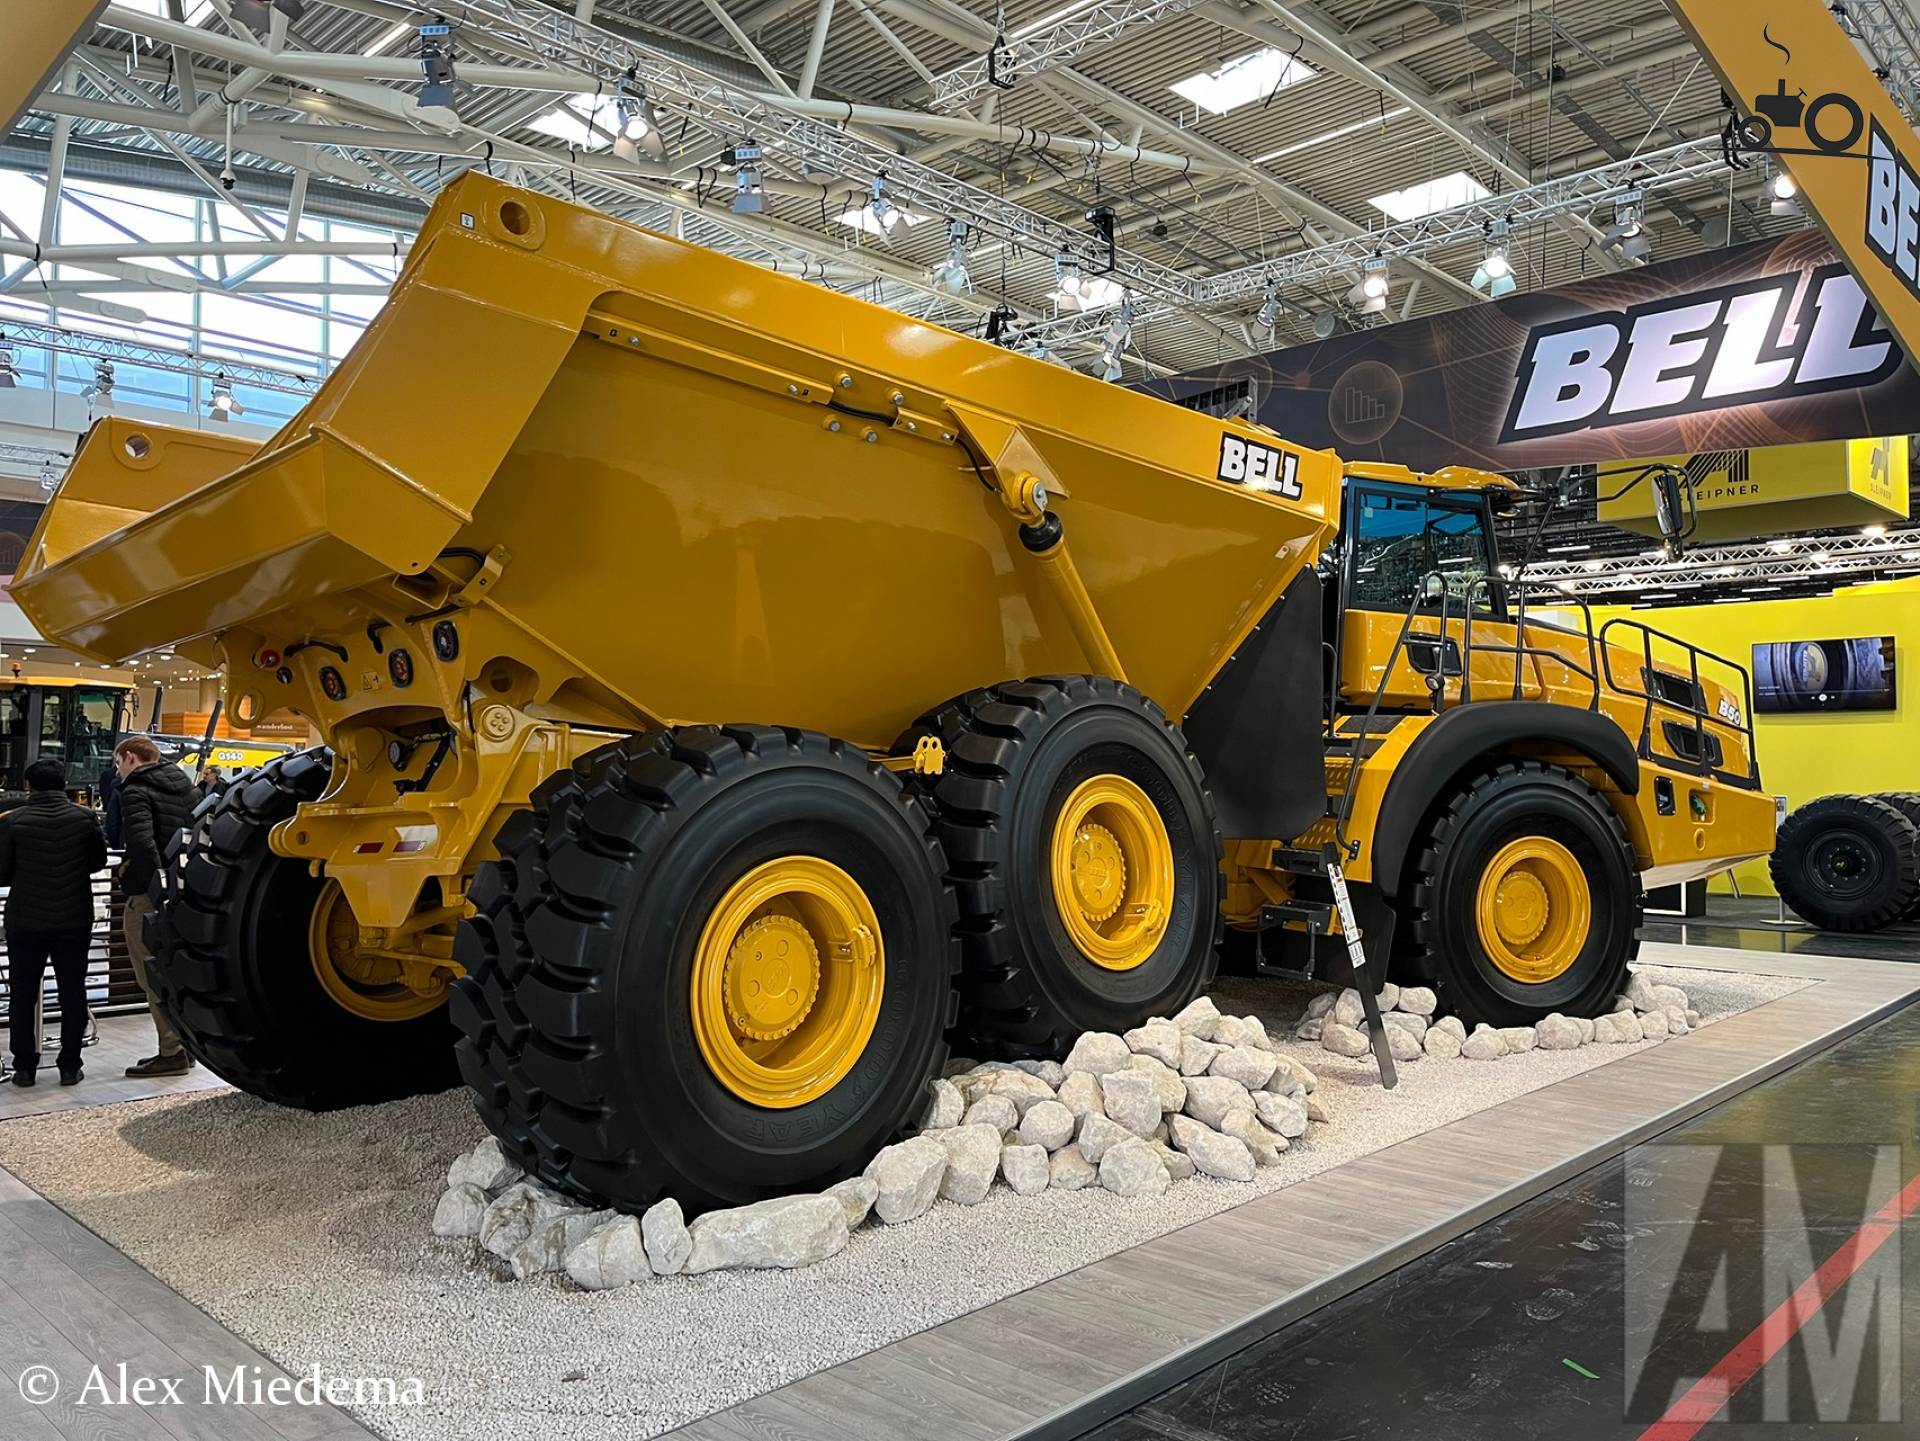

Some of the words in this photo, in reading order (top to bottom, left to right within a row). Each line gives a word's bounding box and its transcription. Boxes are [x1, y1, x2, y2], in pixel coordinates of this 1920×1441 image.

[1869, 130, 1920, 290] BE
[1513, 274, 1893, 431] BELL
[1219, 436, 1302, 498] BELL
[1680, 484, 1759, 501] EIPNER
